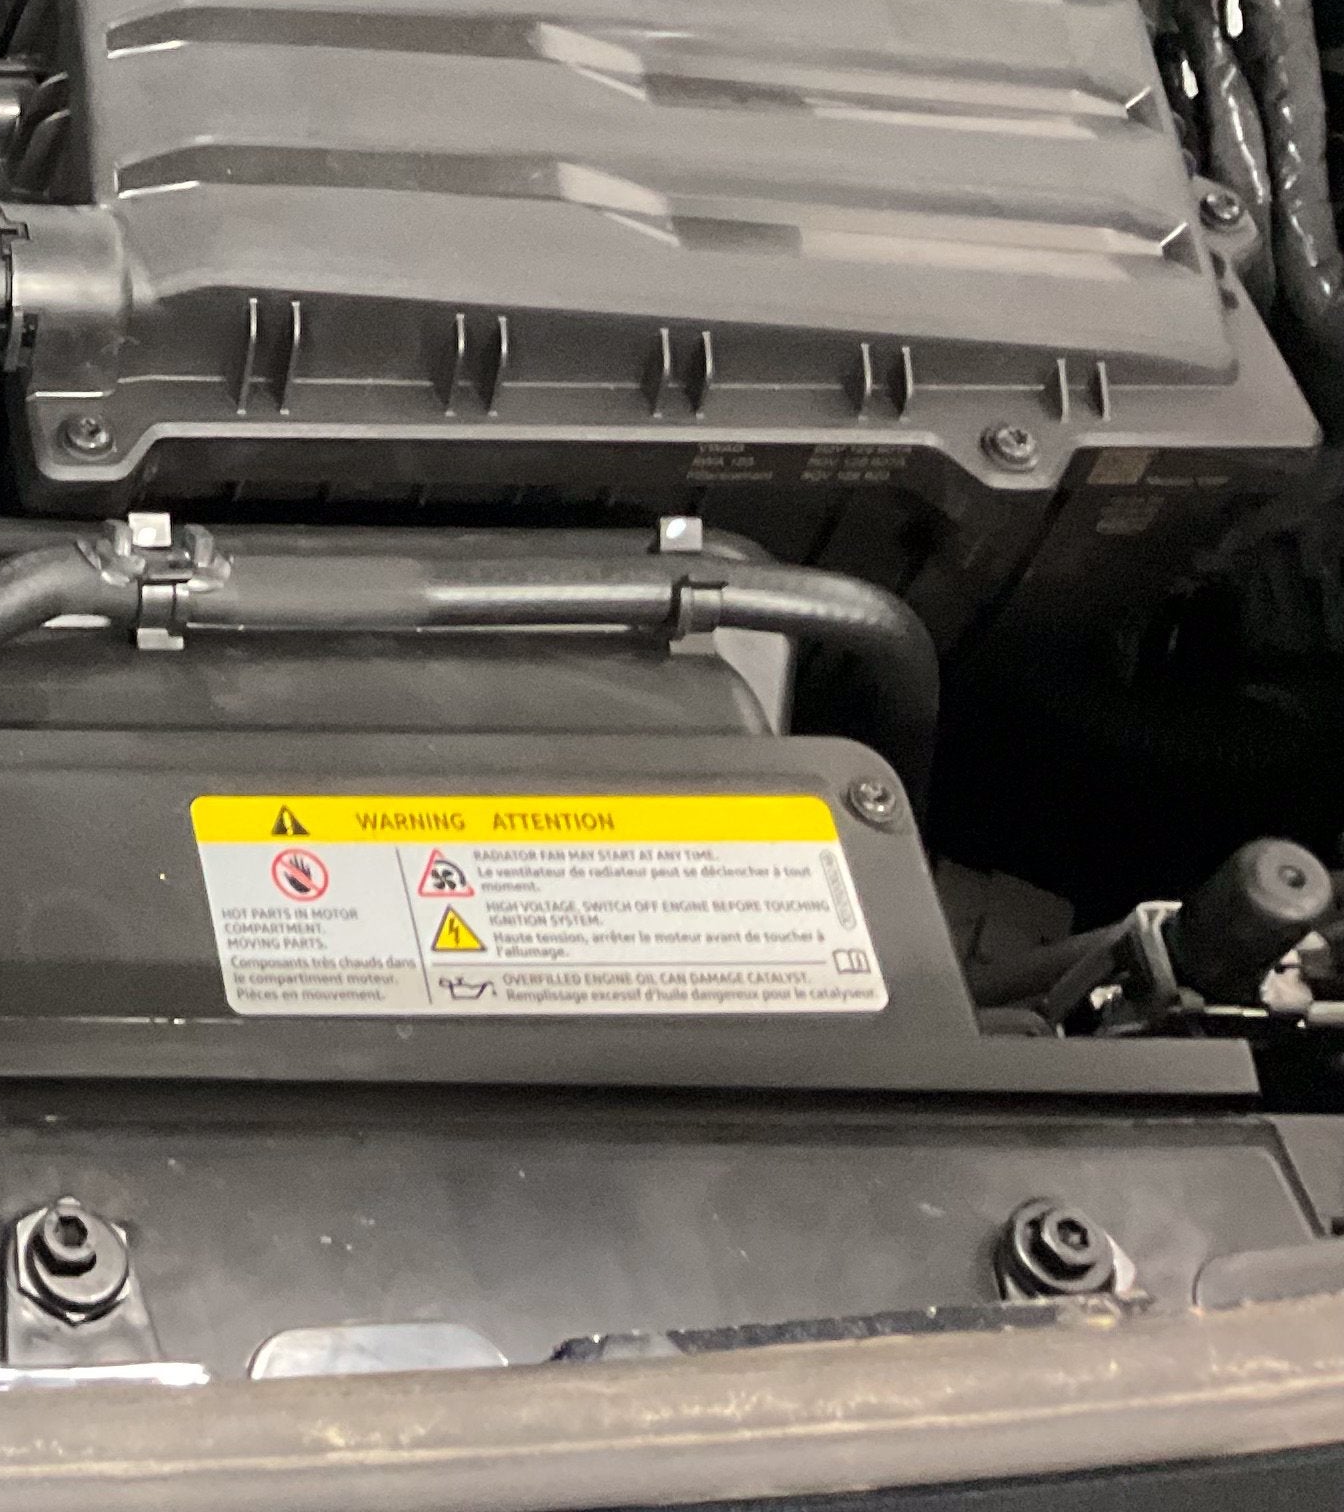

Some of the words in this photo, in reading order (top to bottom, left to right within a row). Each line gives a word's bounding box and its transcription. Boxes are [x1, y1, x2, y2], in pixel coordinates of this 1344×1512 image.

[356, 812, 466, 831] WARNING
[493, 812, 615, 831] ATTENTION
[473, 849, 537, 861] RADIATOR
[540, 849, 565, 861] FAN
[568, 849, 594, 861] MAY
[598, 849, 635, 861] START
[639, 849, 653, 861] AT
[657, 849, 681, 861] ANY
[684, 849, 718, 861] TIME.
[486, 901, 517, 912] HIGH
[582, 901, 631, 912] SWITCH
[635, 901, 658, 912] OFF
[663, 901, 709, 912] ENGINE
[712, 901, 761, 912] BEFORE
[765, 901, 830, 912] TOUCHING
[222, 908, 248, 921] HOT
[251, 908, 291, 921] PARTS
[294, 908, 309, 921] IN
[312, 908, 359, 921] MOTOR
[224, 923, 325, 935] COMPARTMENT.
[228, 938, 280, 950] MOVING
[283, 938, 328, 950] PARTS.
[230, 955, 309, 971] Composants
[312, 955, 336, 968] très
[339, 955, 383, 968] chauds
[386, 955, 416, 968] dans
[234, 973, 246, 985] le
[249, 973, 343, 987] compartiment
[347, 973, 398, 985] moteur.
[502, 973, 581, 985] OVERFILLED
[584, 973, 632, 985] ENGINE
[636, 973, 657, 985] OIL
[660, 973, 687, 985] CAN
[690, 973, 743, 985] DAMAGE
[748, 973, 810, 985] CATALYST.
[237, 988, 278, 1001] Pièces
[282, 991, 298, 1001] en
[302, 990, 386, 1001] mouvement.
